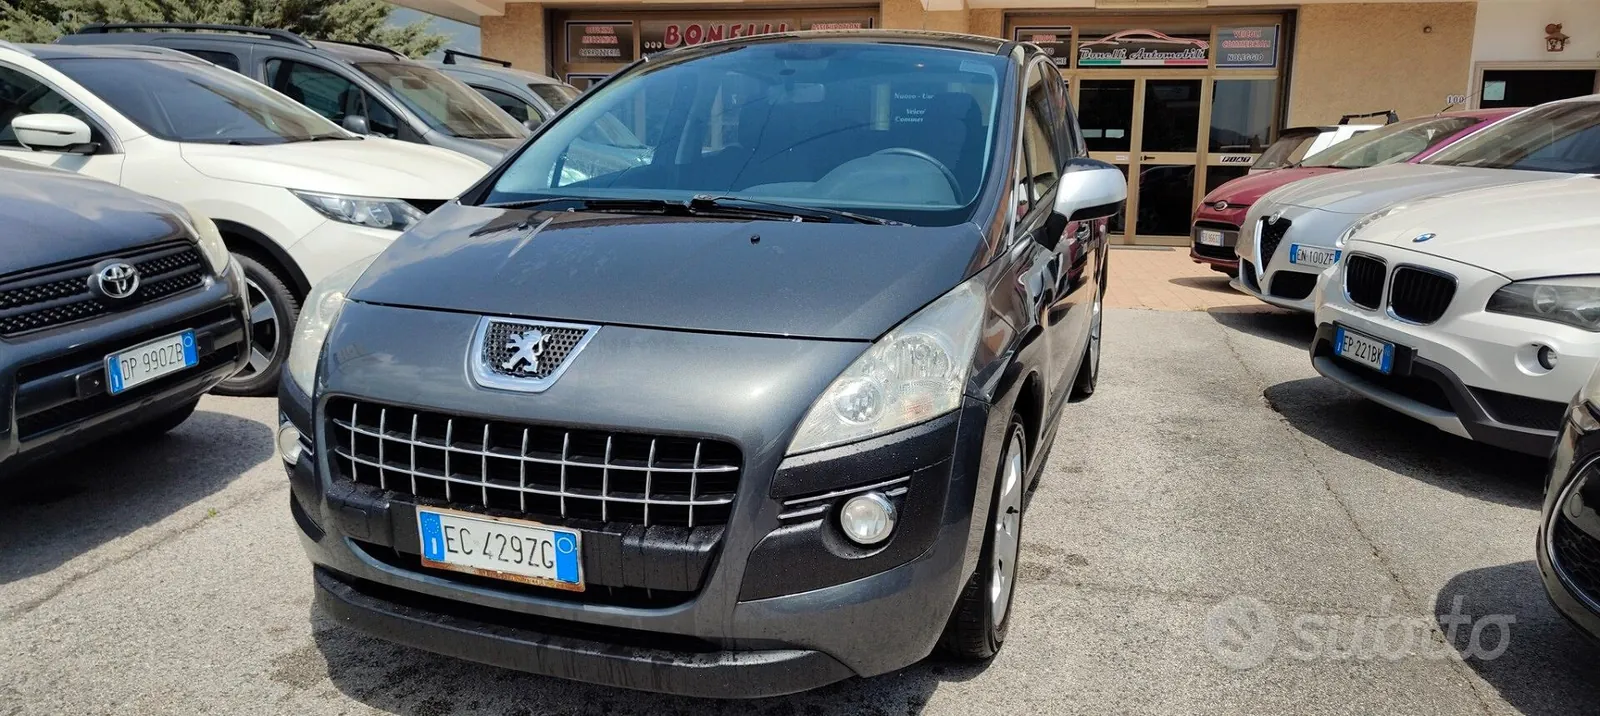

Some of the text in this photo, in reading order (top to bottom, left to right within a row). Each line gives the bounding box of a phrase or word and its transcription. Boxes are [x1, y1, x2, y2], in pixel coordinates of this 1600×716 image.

[1079, 47, 1206, 60] Bonelli Automobili
[1227, 53, 1264, 61] NOLEGGIO
[1297, 249, 1306, 261] EN
[1309, 250, 1334, 265] 100ZF
[1342, 335, 1354, 353] EP
[1355, 340, 1383, 364] 221BK
[121, 357, 137, 380] DP
[143, 343, 184, 373] 990ZB
[444, 525, 474, 555] EC
[482, 531, 554, 569] 429ZG
